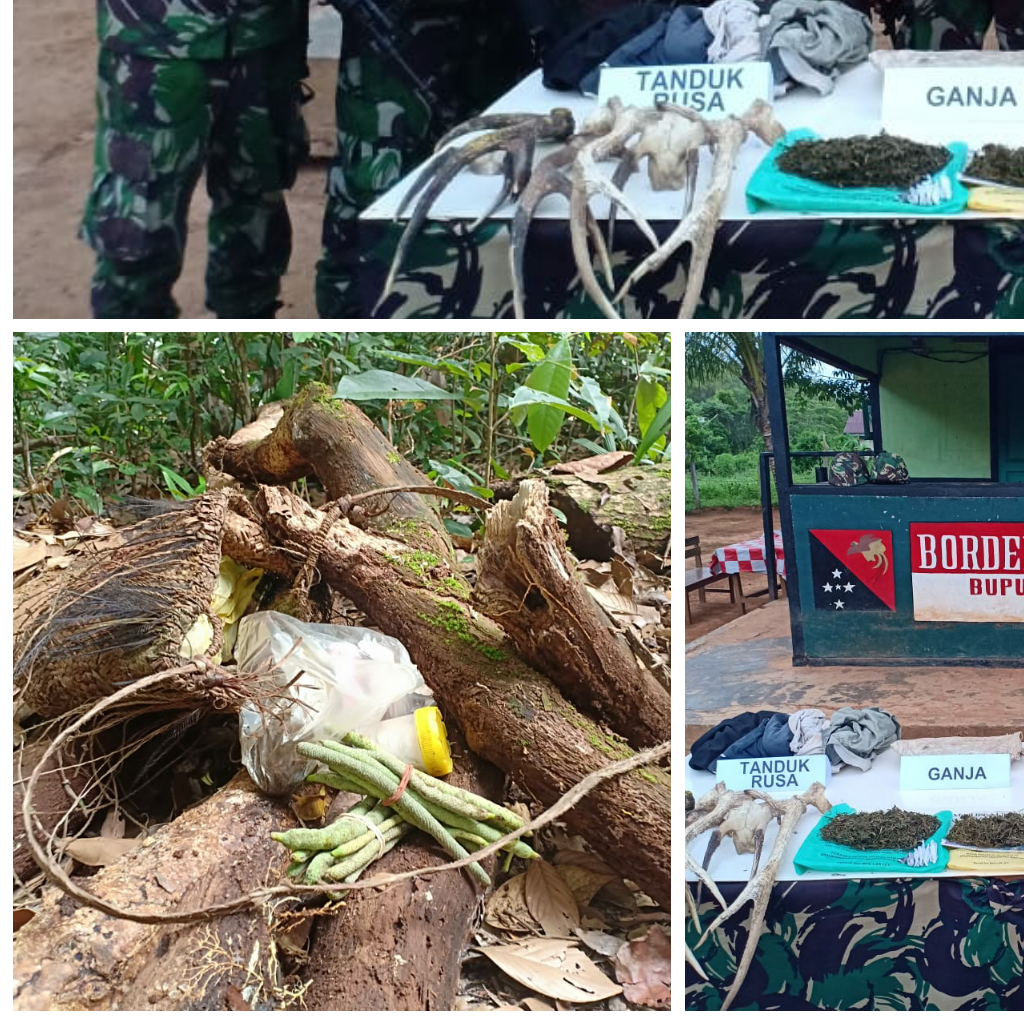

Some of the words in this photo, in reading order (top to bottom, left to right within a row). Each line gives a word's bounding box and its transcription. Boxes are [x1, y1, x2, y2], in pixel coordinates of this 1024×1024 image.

[635, 67, 744, 92] TANDUK
[653, 91, 725, 112] RUSA
[926, 86, 1018, 108] GANJA
[740, 758, 810, 775] TANDUK
[928, 766, 987, 780] GANJA
[751, 774, 799, 788] RUSA
